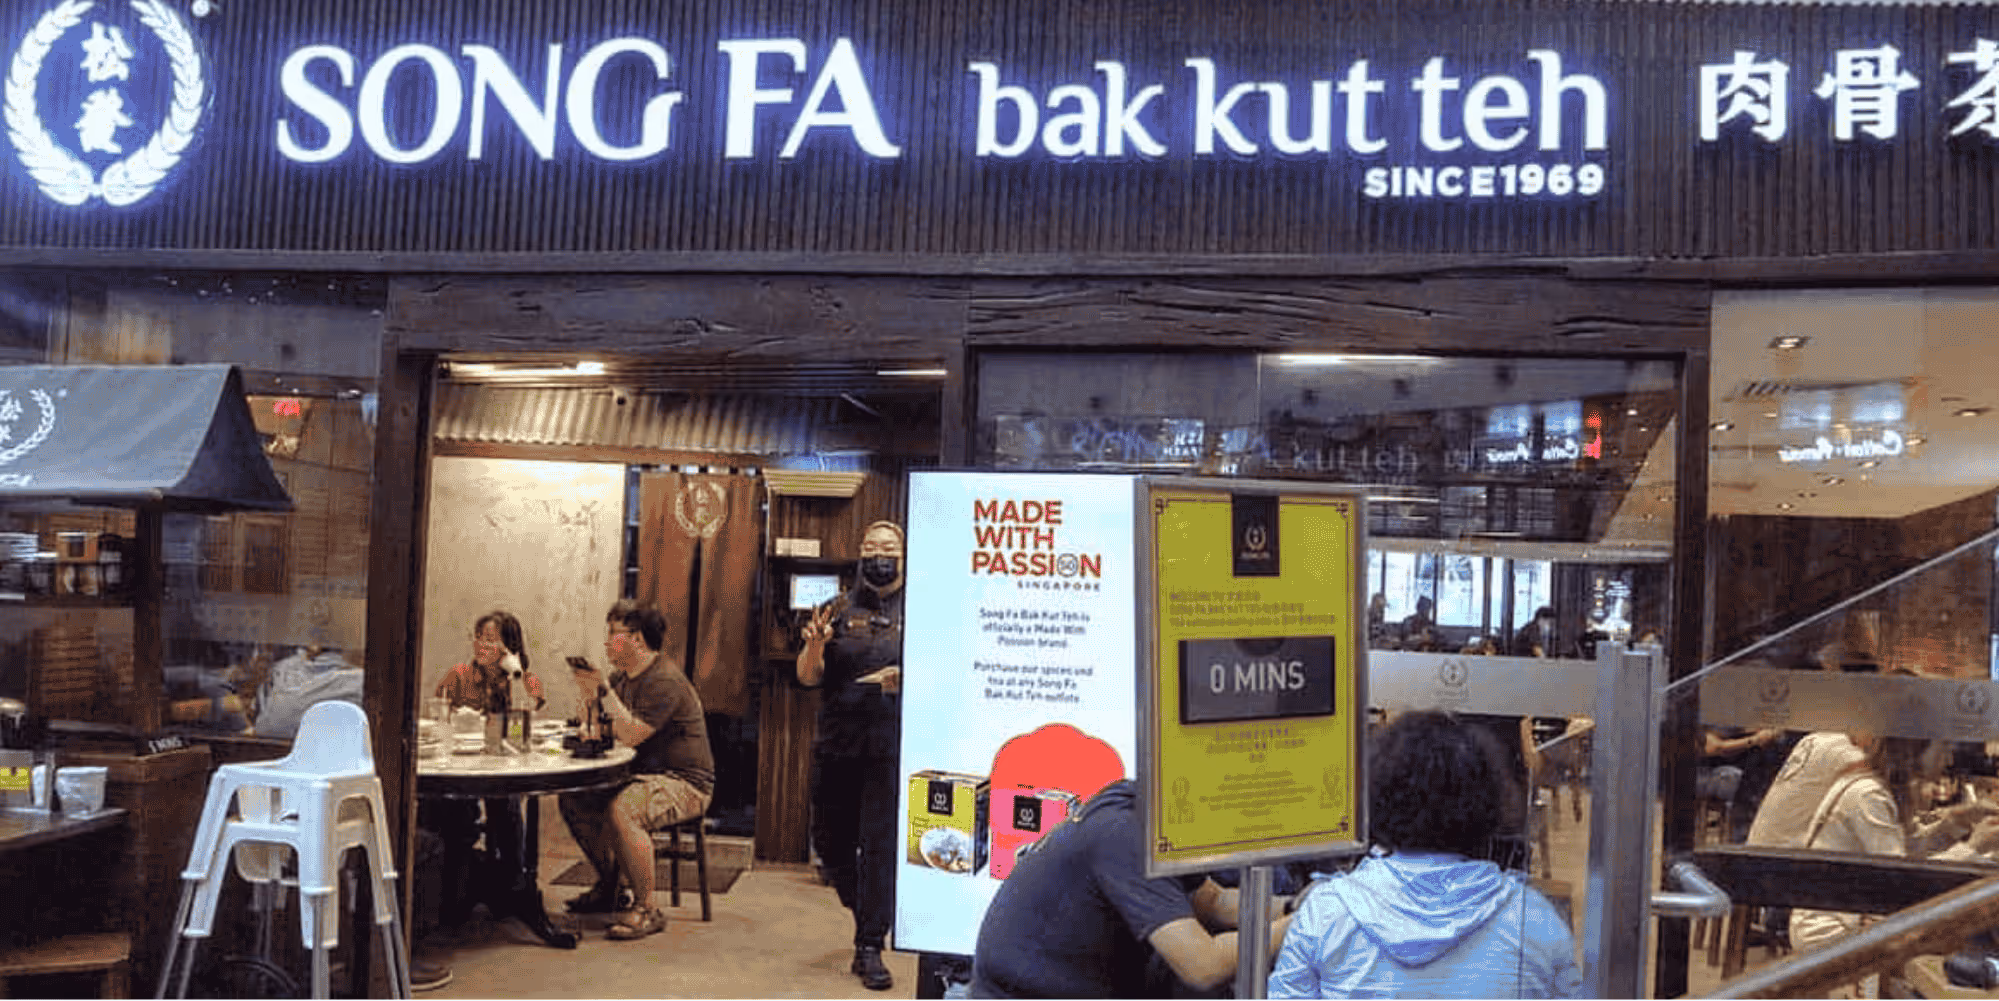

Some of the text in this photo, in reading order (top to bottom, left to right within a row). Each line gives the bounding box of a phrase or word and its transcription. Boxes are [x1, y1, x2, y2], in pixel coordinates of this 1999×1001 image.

[277, 38, 900, 163] SONG FA
[970, 50, 1607, 156] bak kut teh
[974, 499, 1063, 524] MADE
[974, 525, 1054, 550] WITH
[1017, 580, 1100, 592] SINGAPORE
[979, 606, 1004, 620] Song
[1006, 608, 1018, 620] Fa
[1020, 609, 1039, 621] Bak
[1042, 610, 1059, 621] Kut
[1034, 624, 1061, 635] Made
[973, 661, 1019, 674] Purchase
[1210, 661, 1305, 693] 0 MINS
